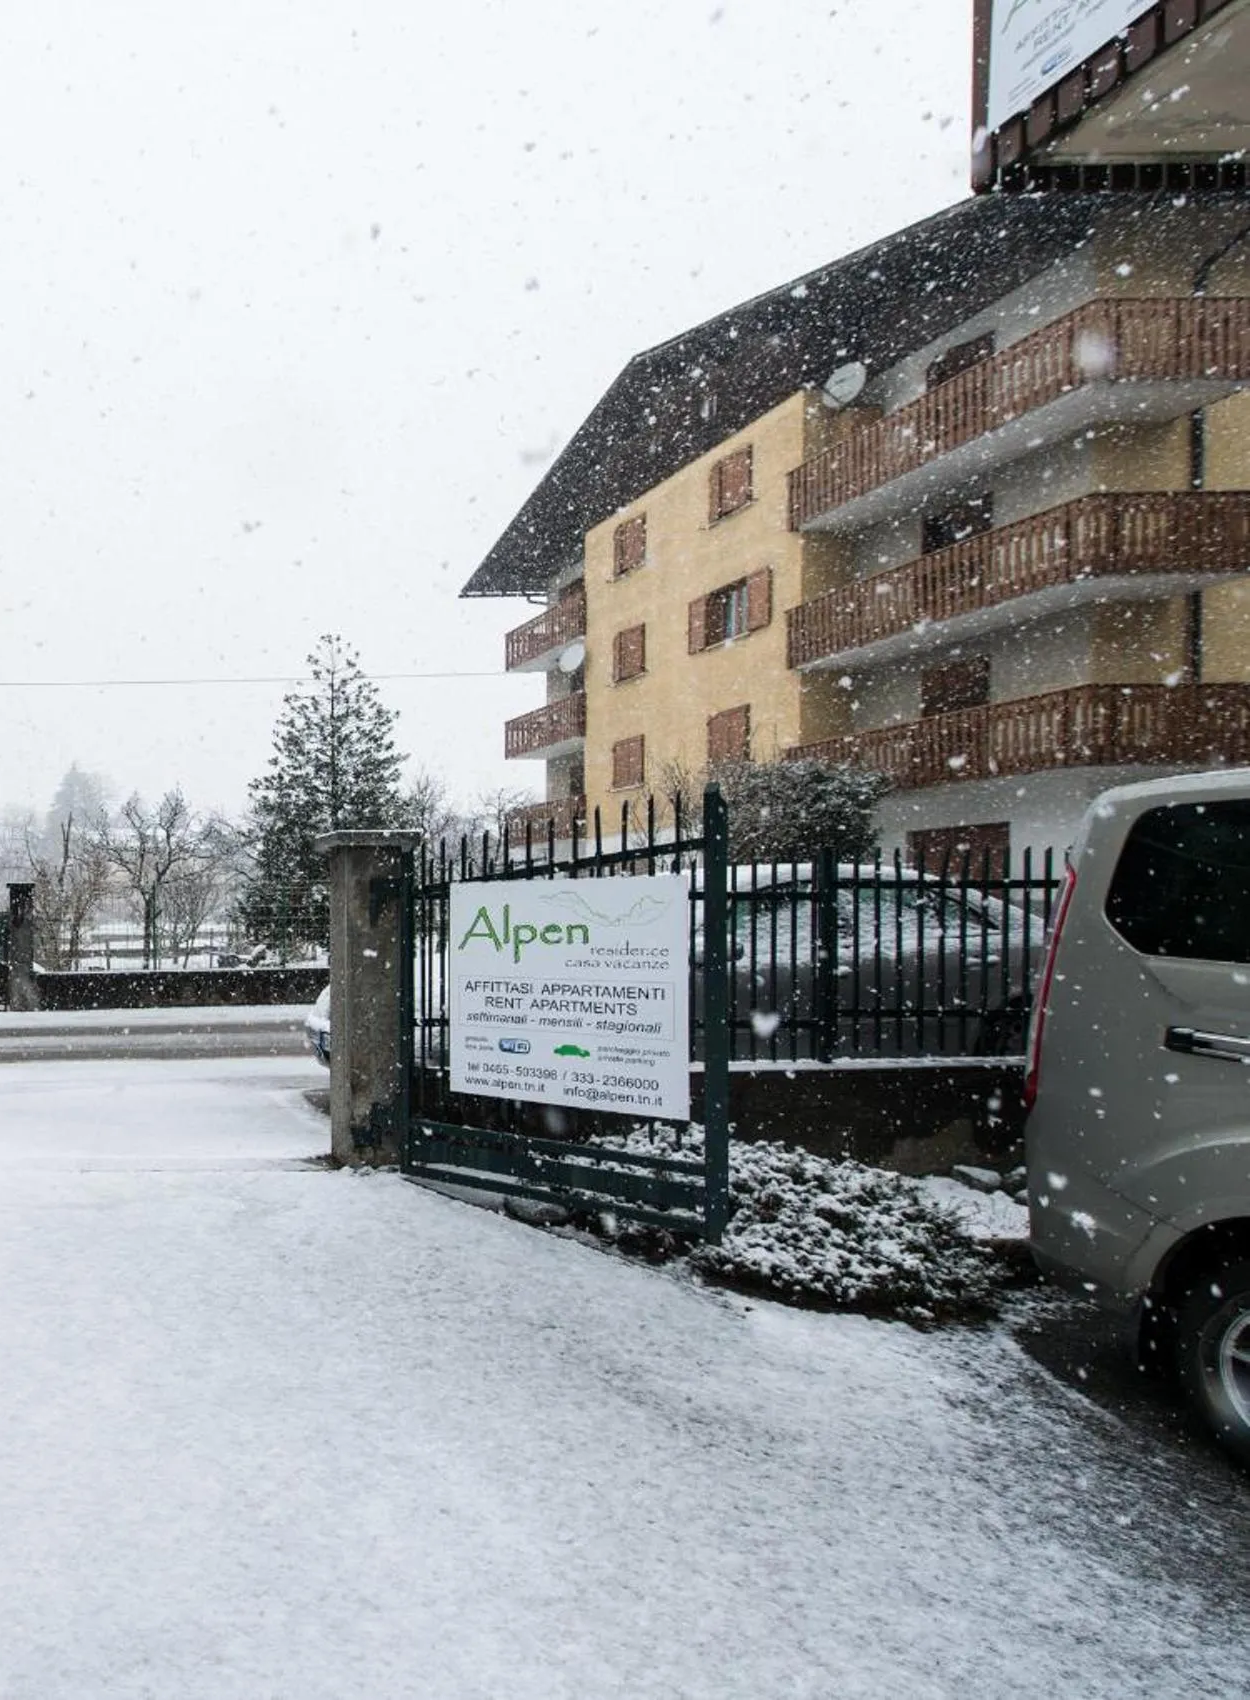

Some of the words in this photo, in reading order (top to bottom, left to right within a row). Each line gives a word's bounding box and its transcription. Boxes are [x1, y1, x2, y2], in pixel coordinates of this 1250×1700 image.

[458, 904, 590, 964] Alpen
[590, 940, 670, 958] residence
[565, 959, 600, 968] casa
[604, 960, 670, 970] vacanze
[464, 980, 534, 994] AFFITTASI
[541, 983, 666, 1001] APPARTAMENTI
[484, 996, 523, 1009] RENT
[529, 999, 638, 1016] APARTMENTS
[466, 1012, 528, 1025] settimanali
[538, 1017, 583, 1029] mensili
[595, 1019, 662, 1034] stagionali
[467, 1062, 480, 1072] tel
[465, 1075, 546, 1092] www.alpen.tn.it
[563, 1086, 664, 1107] info@alpen.tn.it
